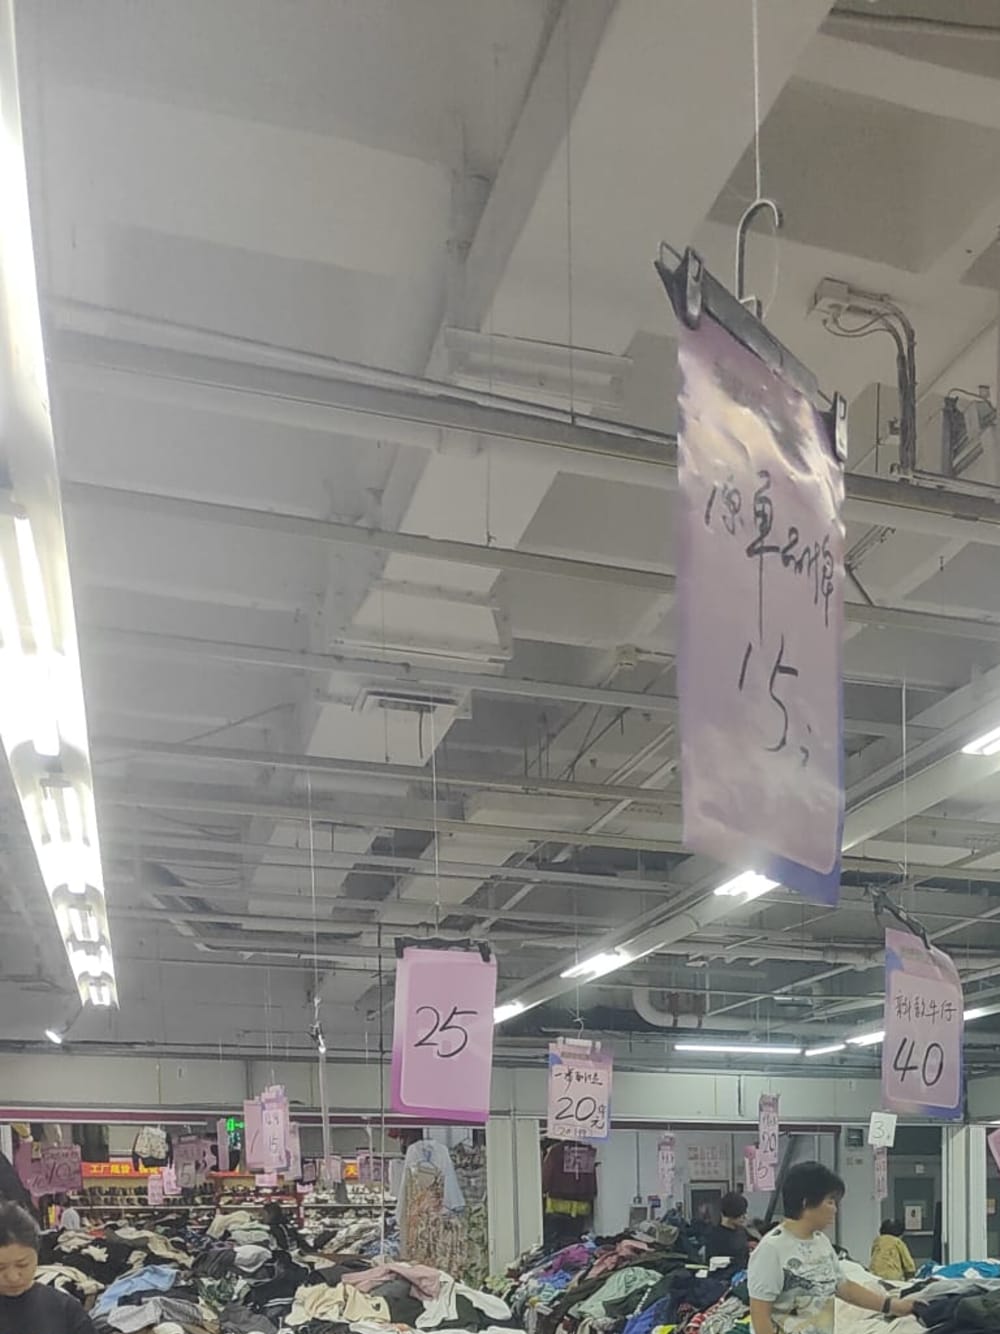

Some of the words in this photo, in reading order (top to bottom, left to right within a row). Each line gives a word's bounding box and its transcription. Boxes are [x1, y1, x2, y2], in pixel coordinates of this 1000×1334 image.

[413, 1006, 478, 1058] 25
[893, 1036, 944, 1087] 40
[555, 1096, 597, 1122] 20
